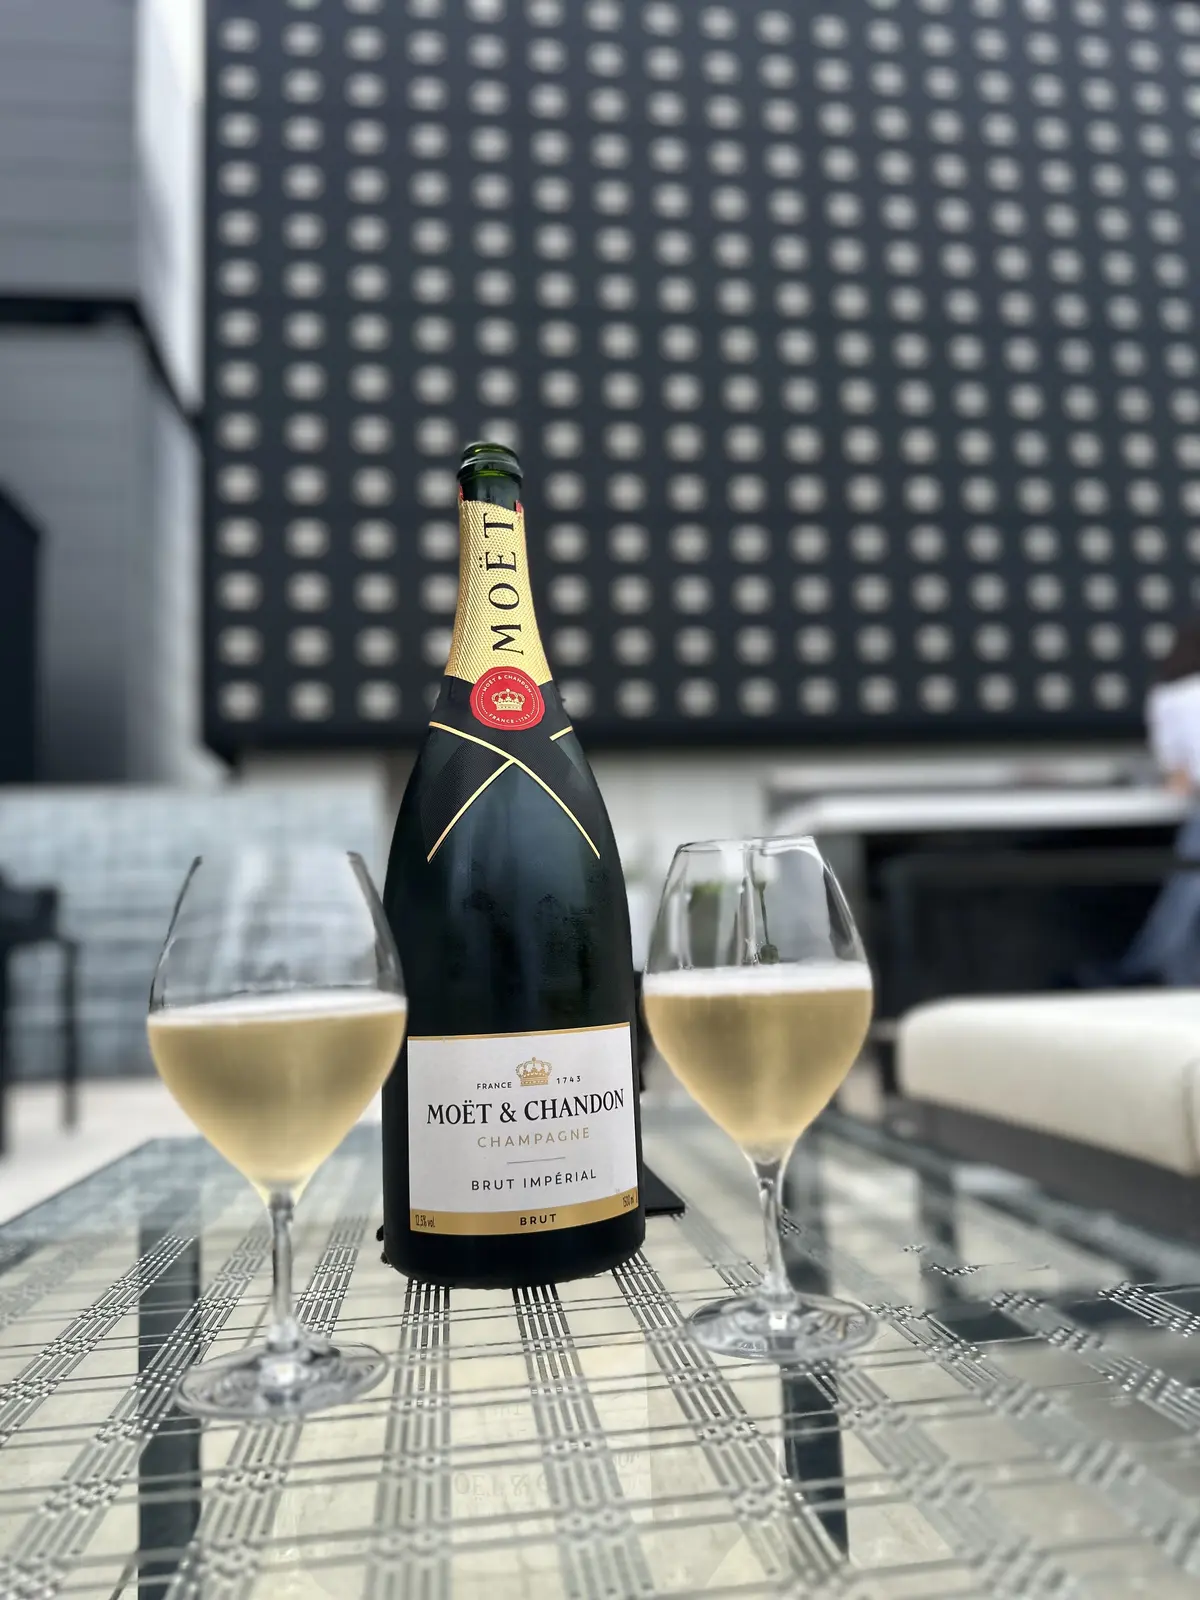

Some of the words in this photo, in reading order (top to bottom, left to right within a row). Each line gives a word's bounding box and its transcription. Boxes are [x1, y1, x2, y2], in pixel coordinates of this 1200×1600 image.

[478, 512, 524, 655] MOËT
[488, 713, 515, 724] FRANCE
[476, 1081, 512, 1090] FRANCE
[556, 1076, 582, 1085] 1743
[426, 1099, 492, 1125] MOËT
[500, 1102, 517, 1123] &
[524, 1088, 624, 1121] CHANDON
[477, 1127, 590, 1148] CHAMPAGNE
[471, 1178, 515, 1191] BRUT
[523, 1168, 597, 1189] IMPÉRIAL
[519, 1213, 557, 1226] BRUT
